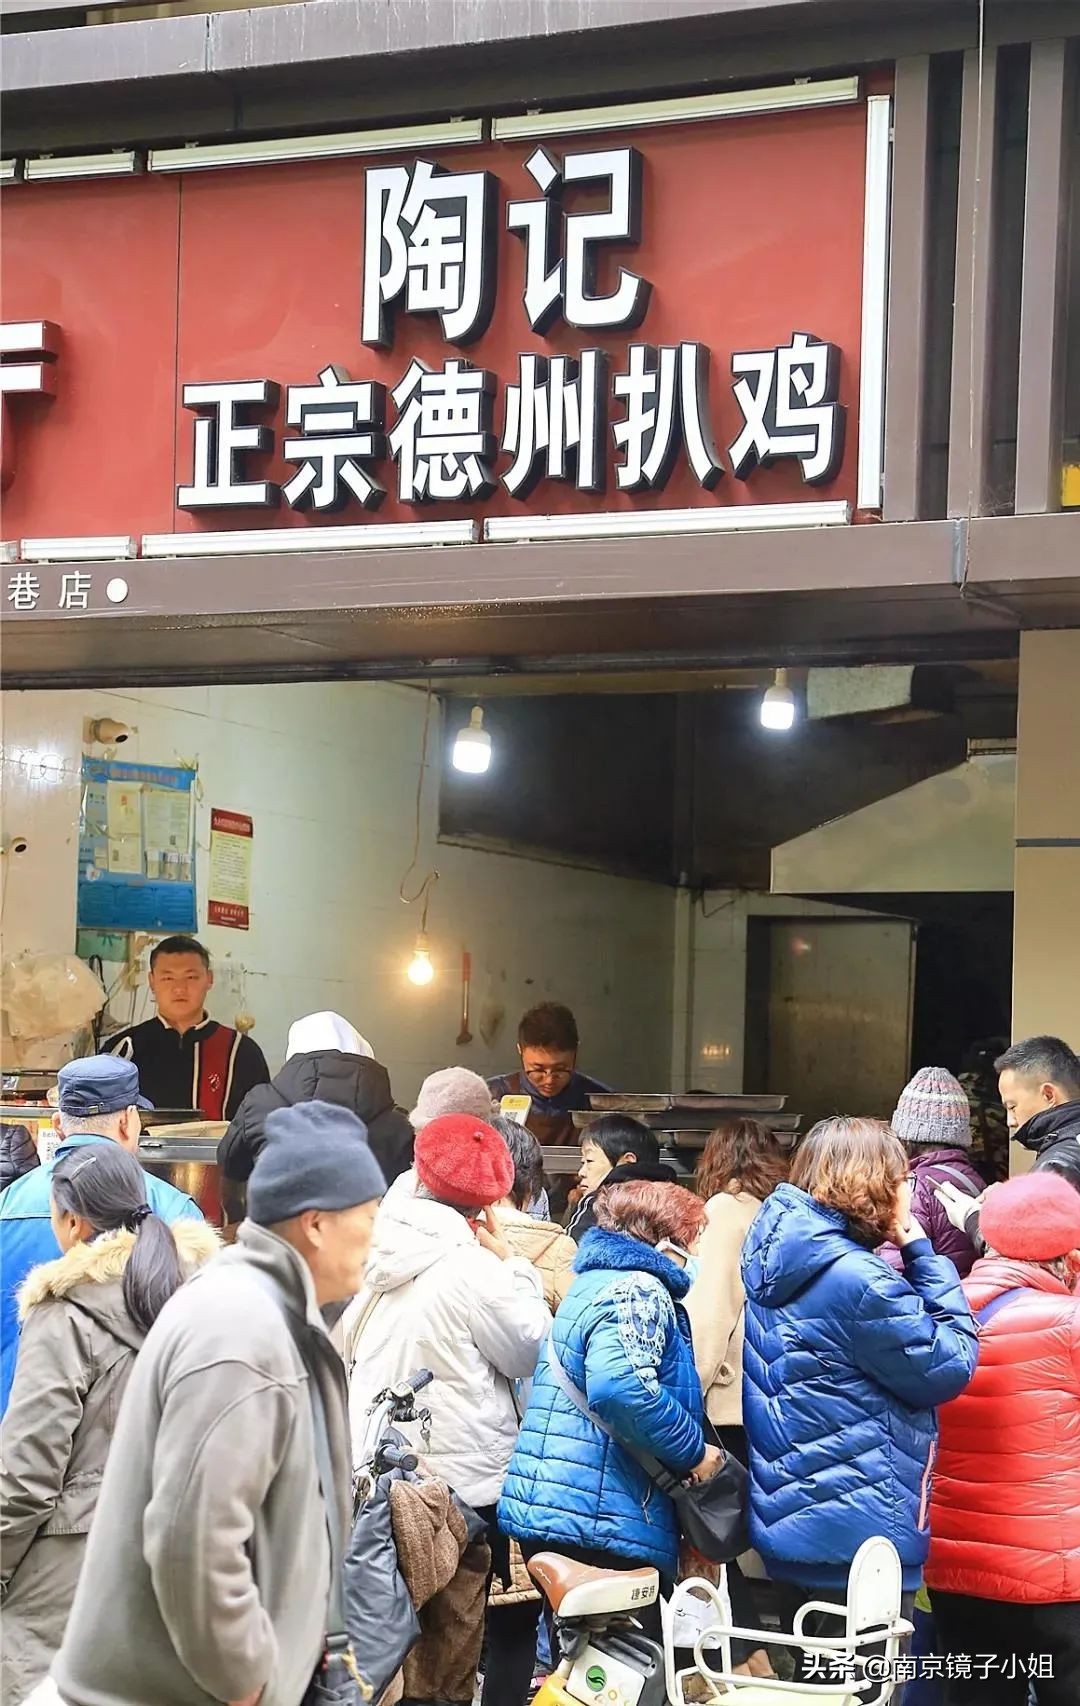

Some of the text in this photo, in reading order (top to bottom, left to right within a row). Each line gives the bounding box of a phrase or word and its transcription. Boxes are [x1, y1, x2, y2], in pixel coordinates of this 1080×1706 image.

[361, 145, 652, 348] 陶记
[177, 332, 845, 510] 正宗德州扒鸡
